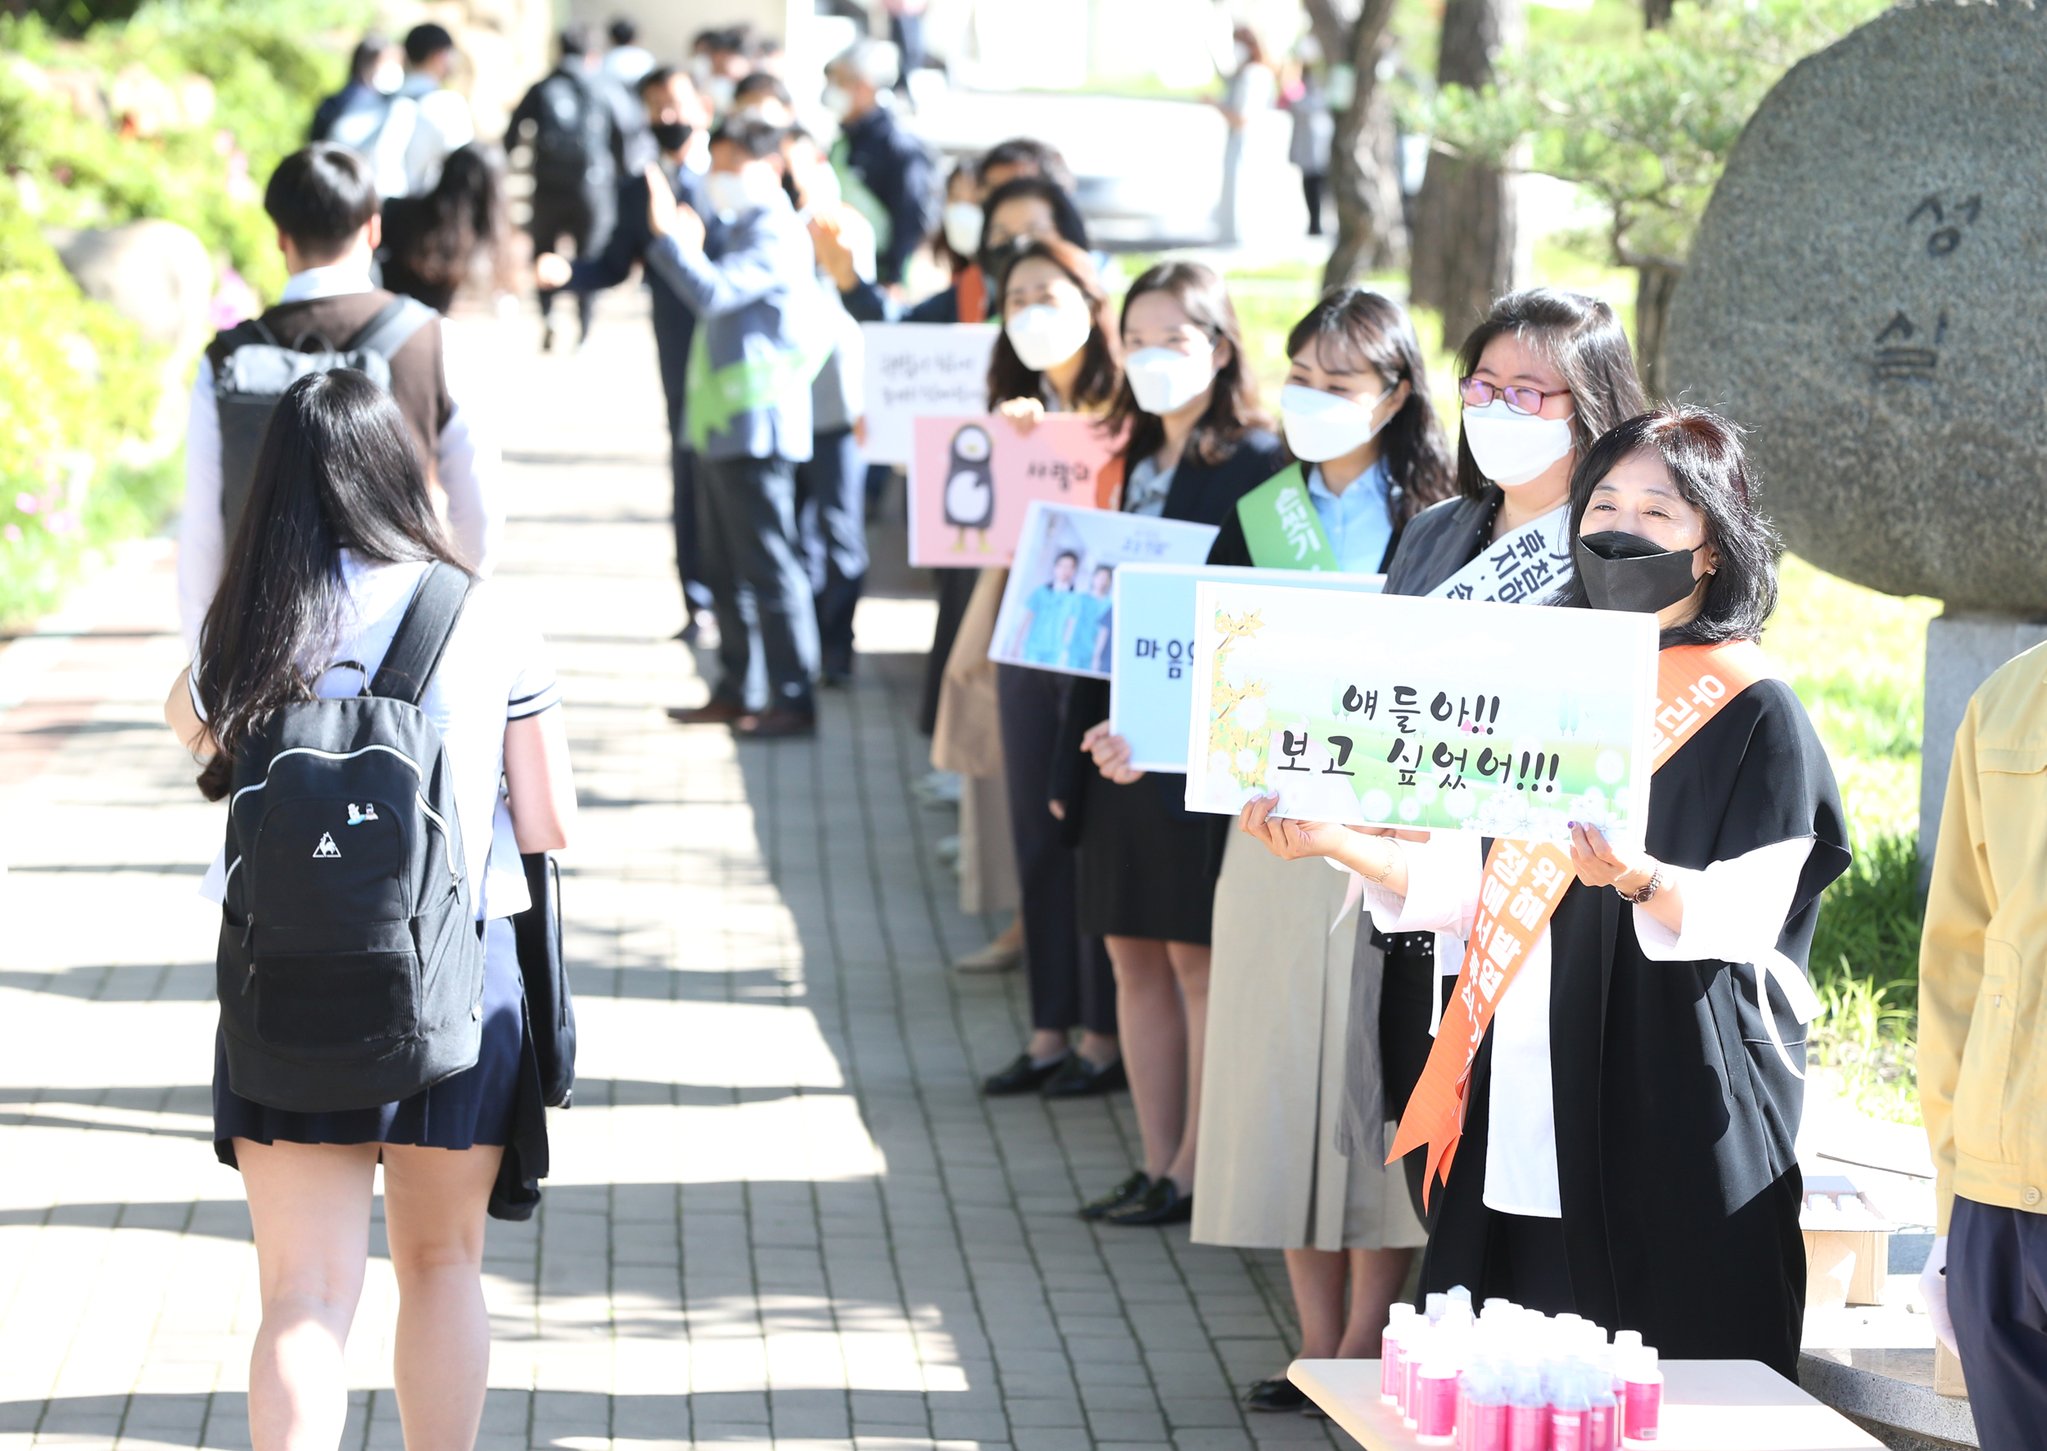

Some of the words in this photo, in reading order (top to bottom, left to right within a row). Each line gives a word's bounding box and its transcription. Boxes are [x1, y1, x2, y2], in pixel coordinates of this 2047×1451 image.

[1277, 730, 1356, 777] 보고
[1386, 737, 1560, 793] 싶었어!!!
[1468, 839, 1541, 949] 정에서
[1509, 858, 1565, 931] 위해
